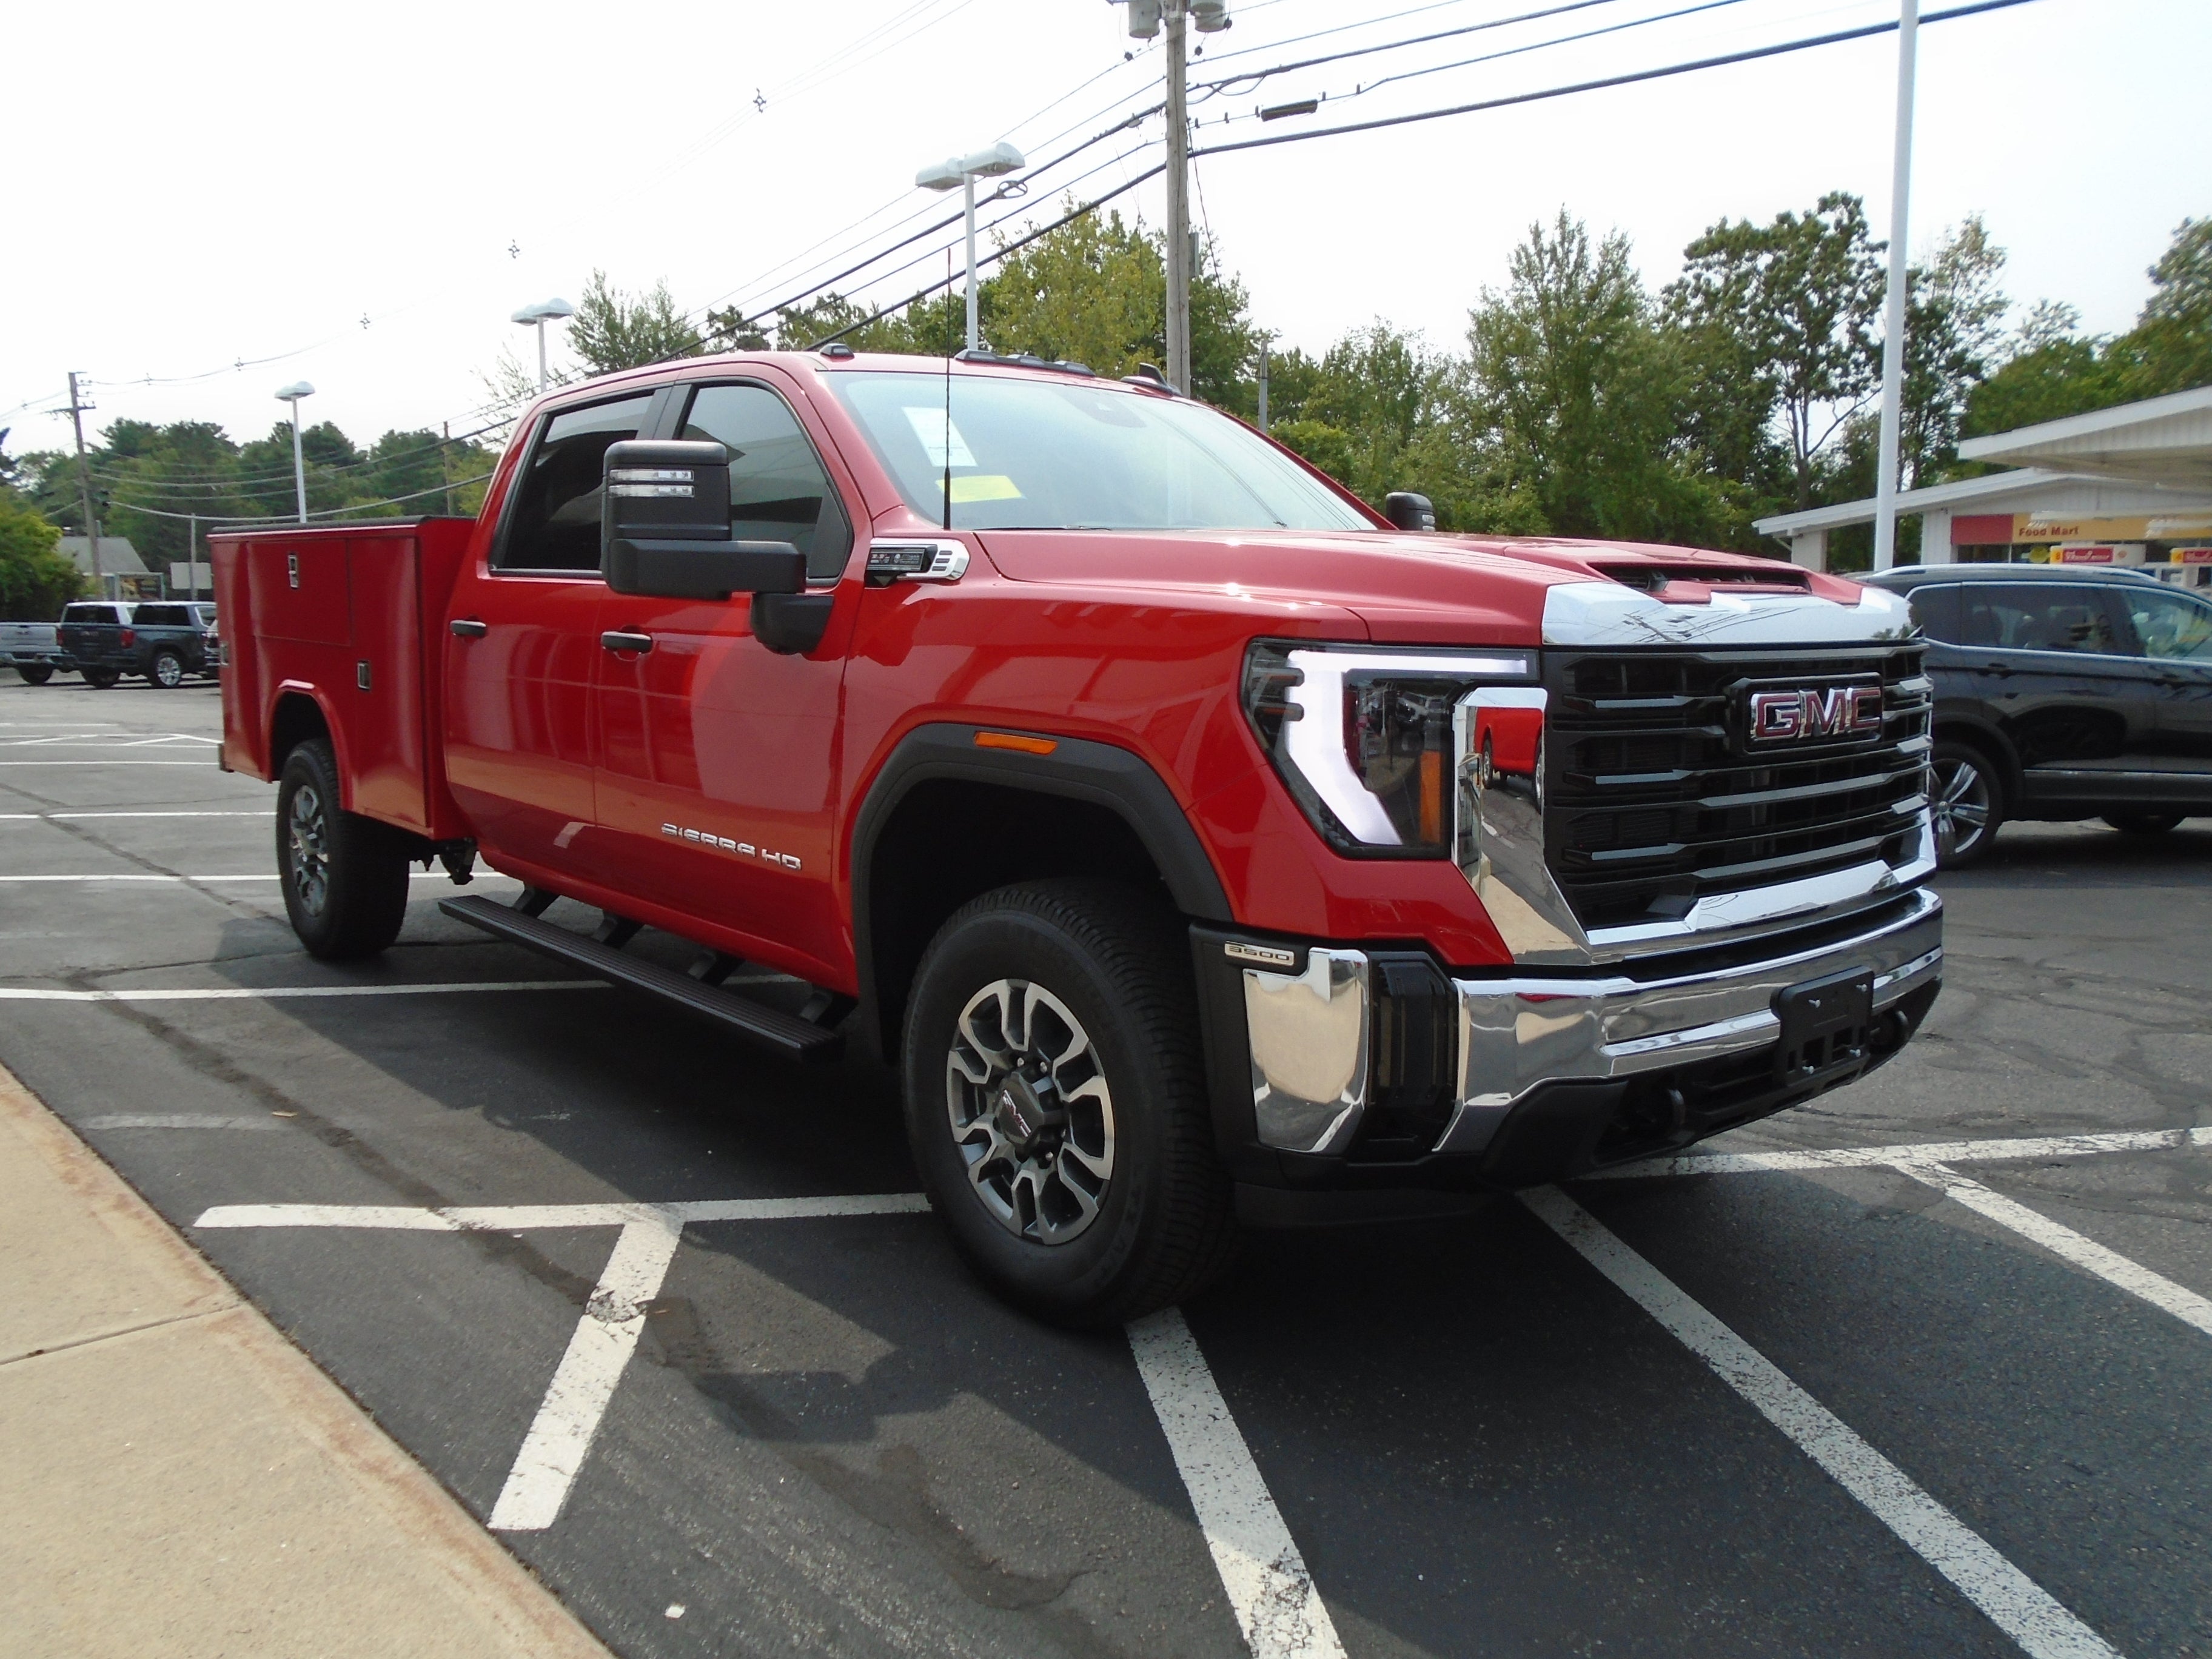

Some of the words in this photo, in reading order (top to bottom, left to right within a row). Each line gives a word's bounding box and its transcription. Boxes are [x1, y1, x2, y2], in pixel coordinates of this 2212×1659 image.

[2019, 528, 2046, 536] Food
[2051, 526, 2078, 535] Mart
[1751, 688, 1881, 741] GMC
[662, 823, 756, 857] SIERRA
[762, 849, 802, 870] HD
[1229, 945, 1290, 960] 3500
